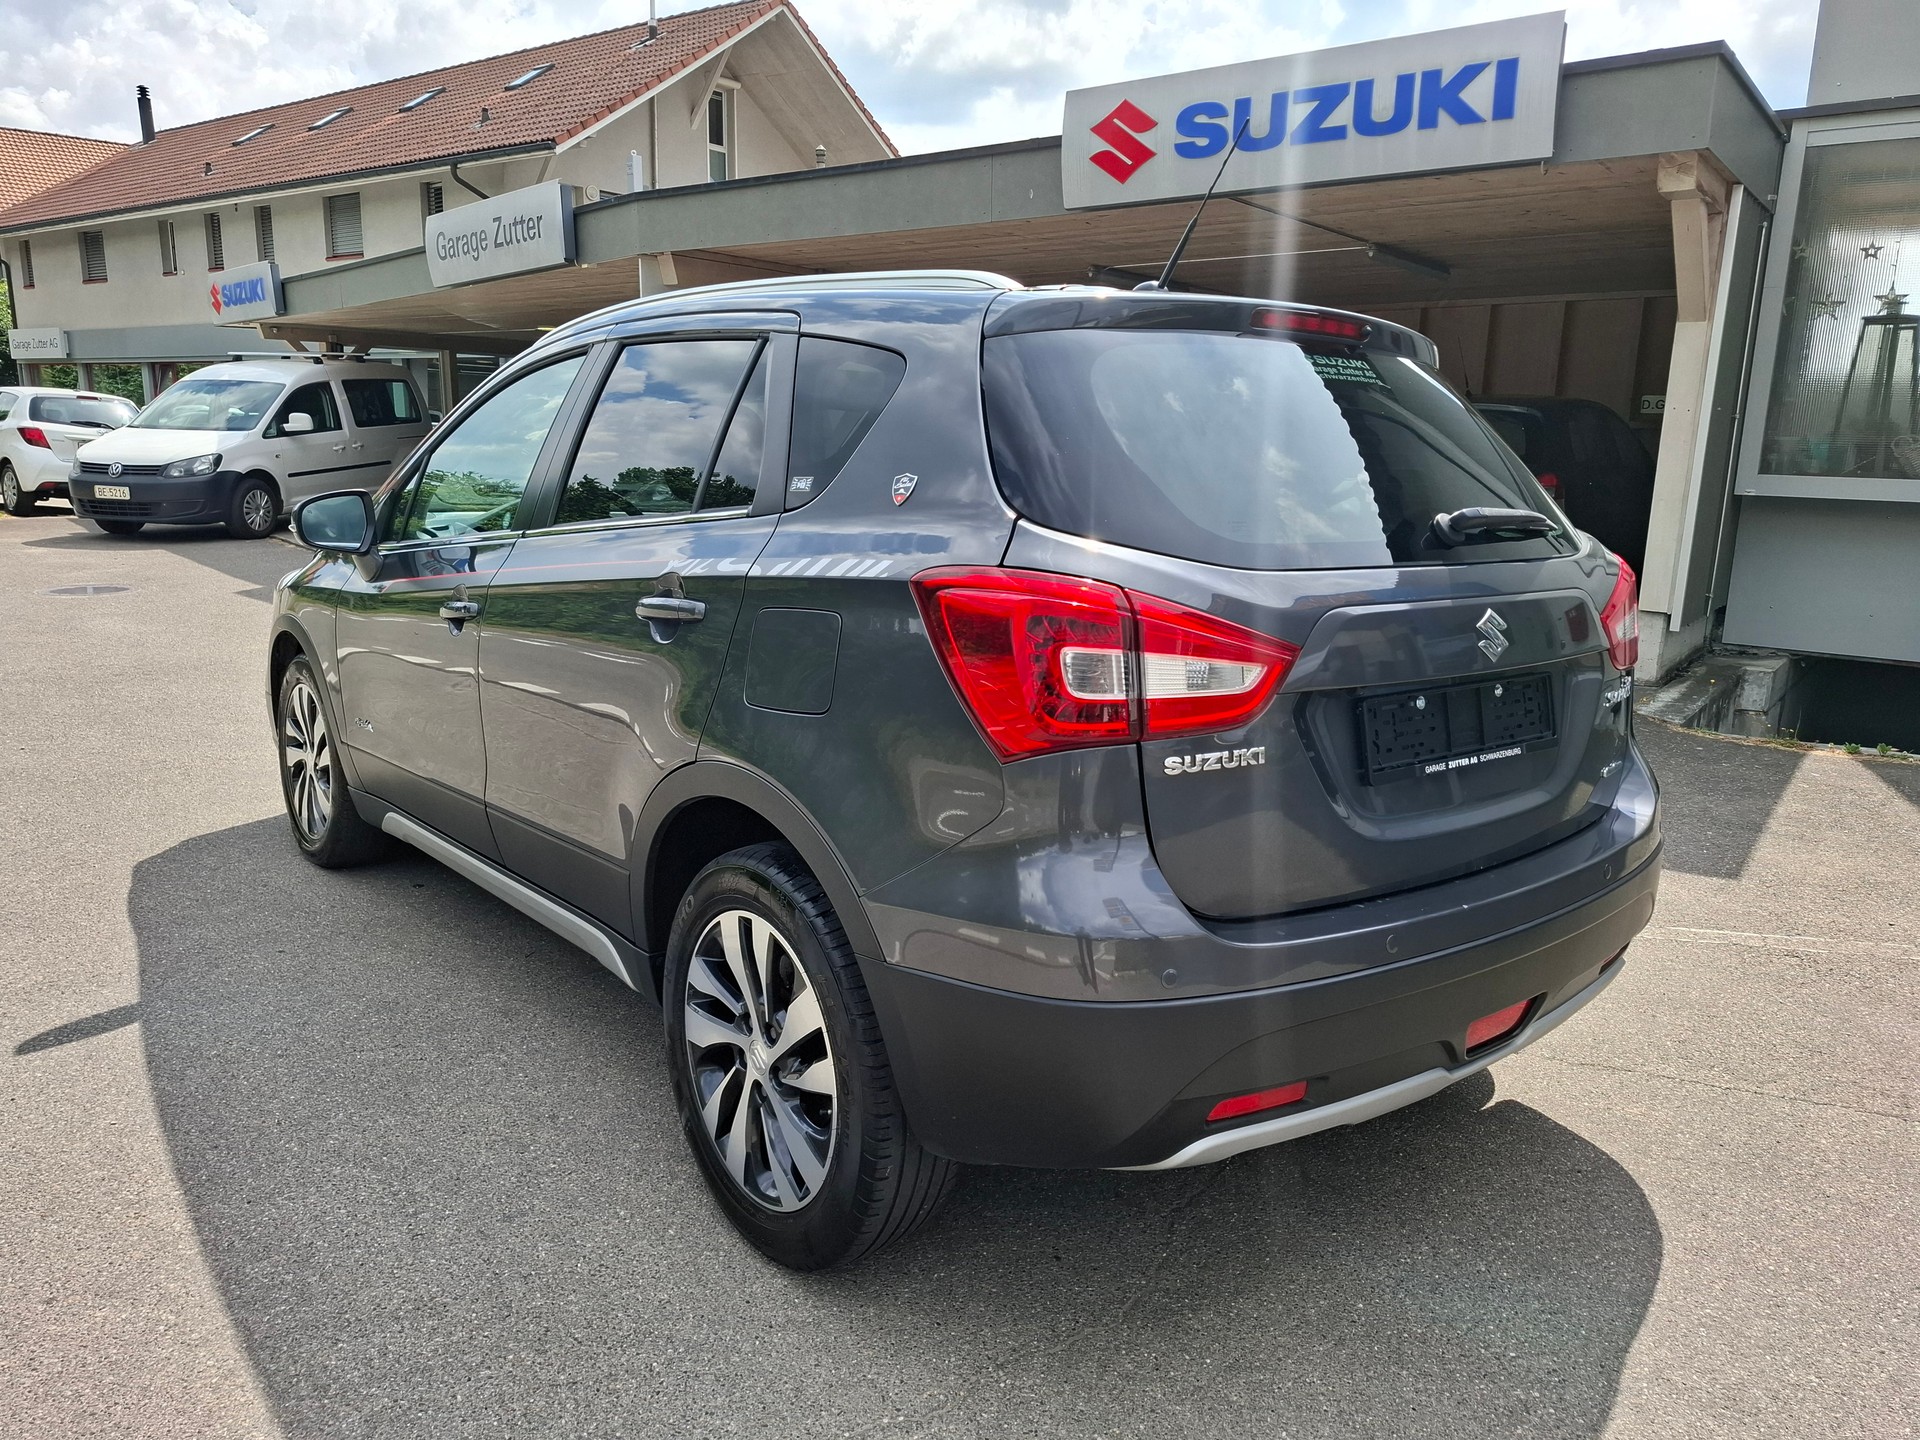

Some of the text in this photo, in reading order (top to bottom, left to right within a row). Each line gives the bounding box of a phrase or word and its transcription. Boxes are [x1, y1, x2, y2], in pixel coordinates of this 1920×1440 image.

[1174, 56, 1520, 160] SUZUKI
[436, 214, 543, 261] Garage Zutter
[221, 277, 266, 308] SUZUKI
[12, 337, 58, 352] Garage Zutter AG
[1312, 366, 1377, 378] arage Zutter AG
[1313, 355, 1370, 369] SUZUKI
[1318, 374, 1384, 385] chwarzenburg
[1163, 746, 1266, 776] SUZUKI
[1425, 763, 1446, 773] GARAGE
[1448, 758, 1469, 769] ZUTTER
[1479, 748, 1521, 762] SCHWARZENBURG
